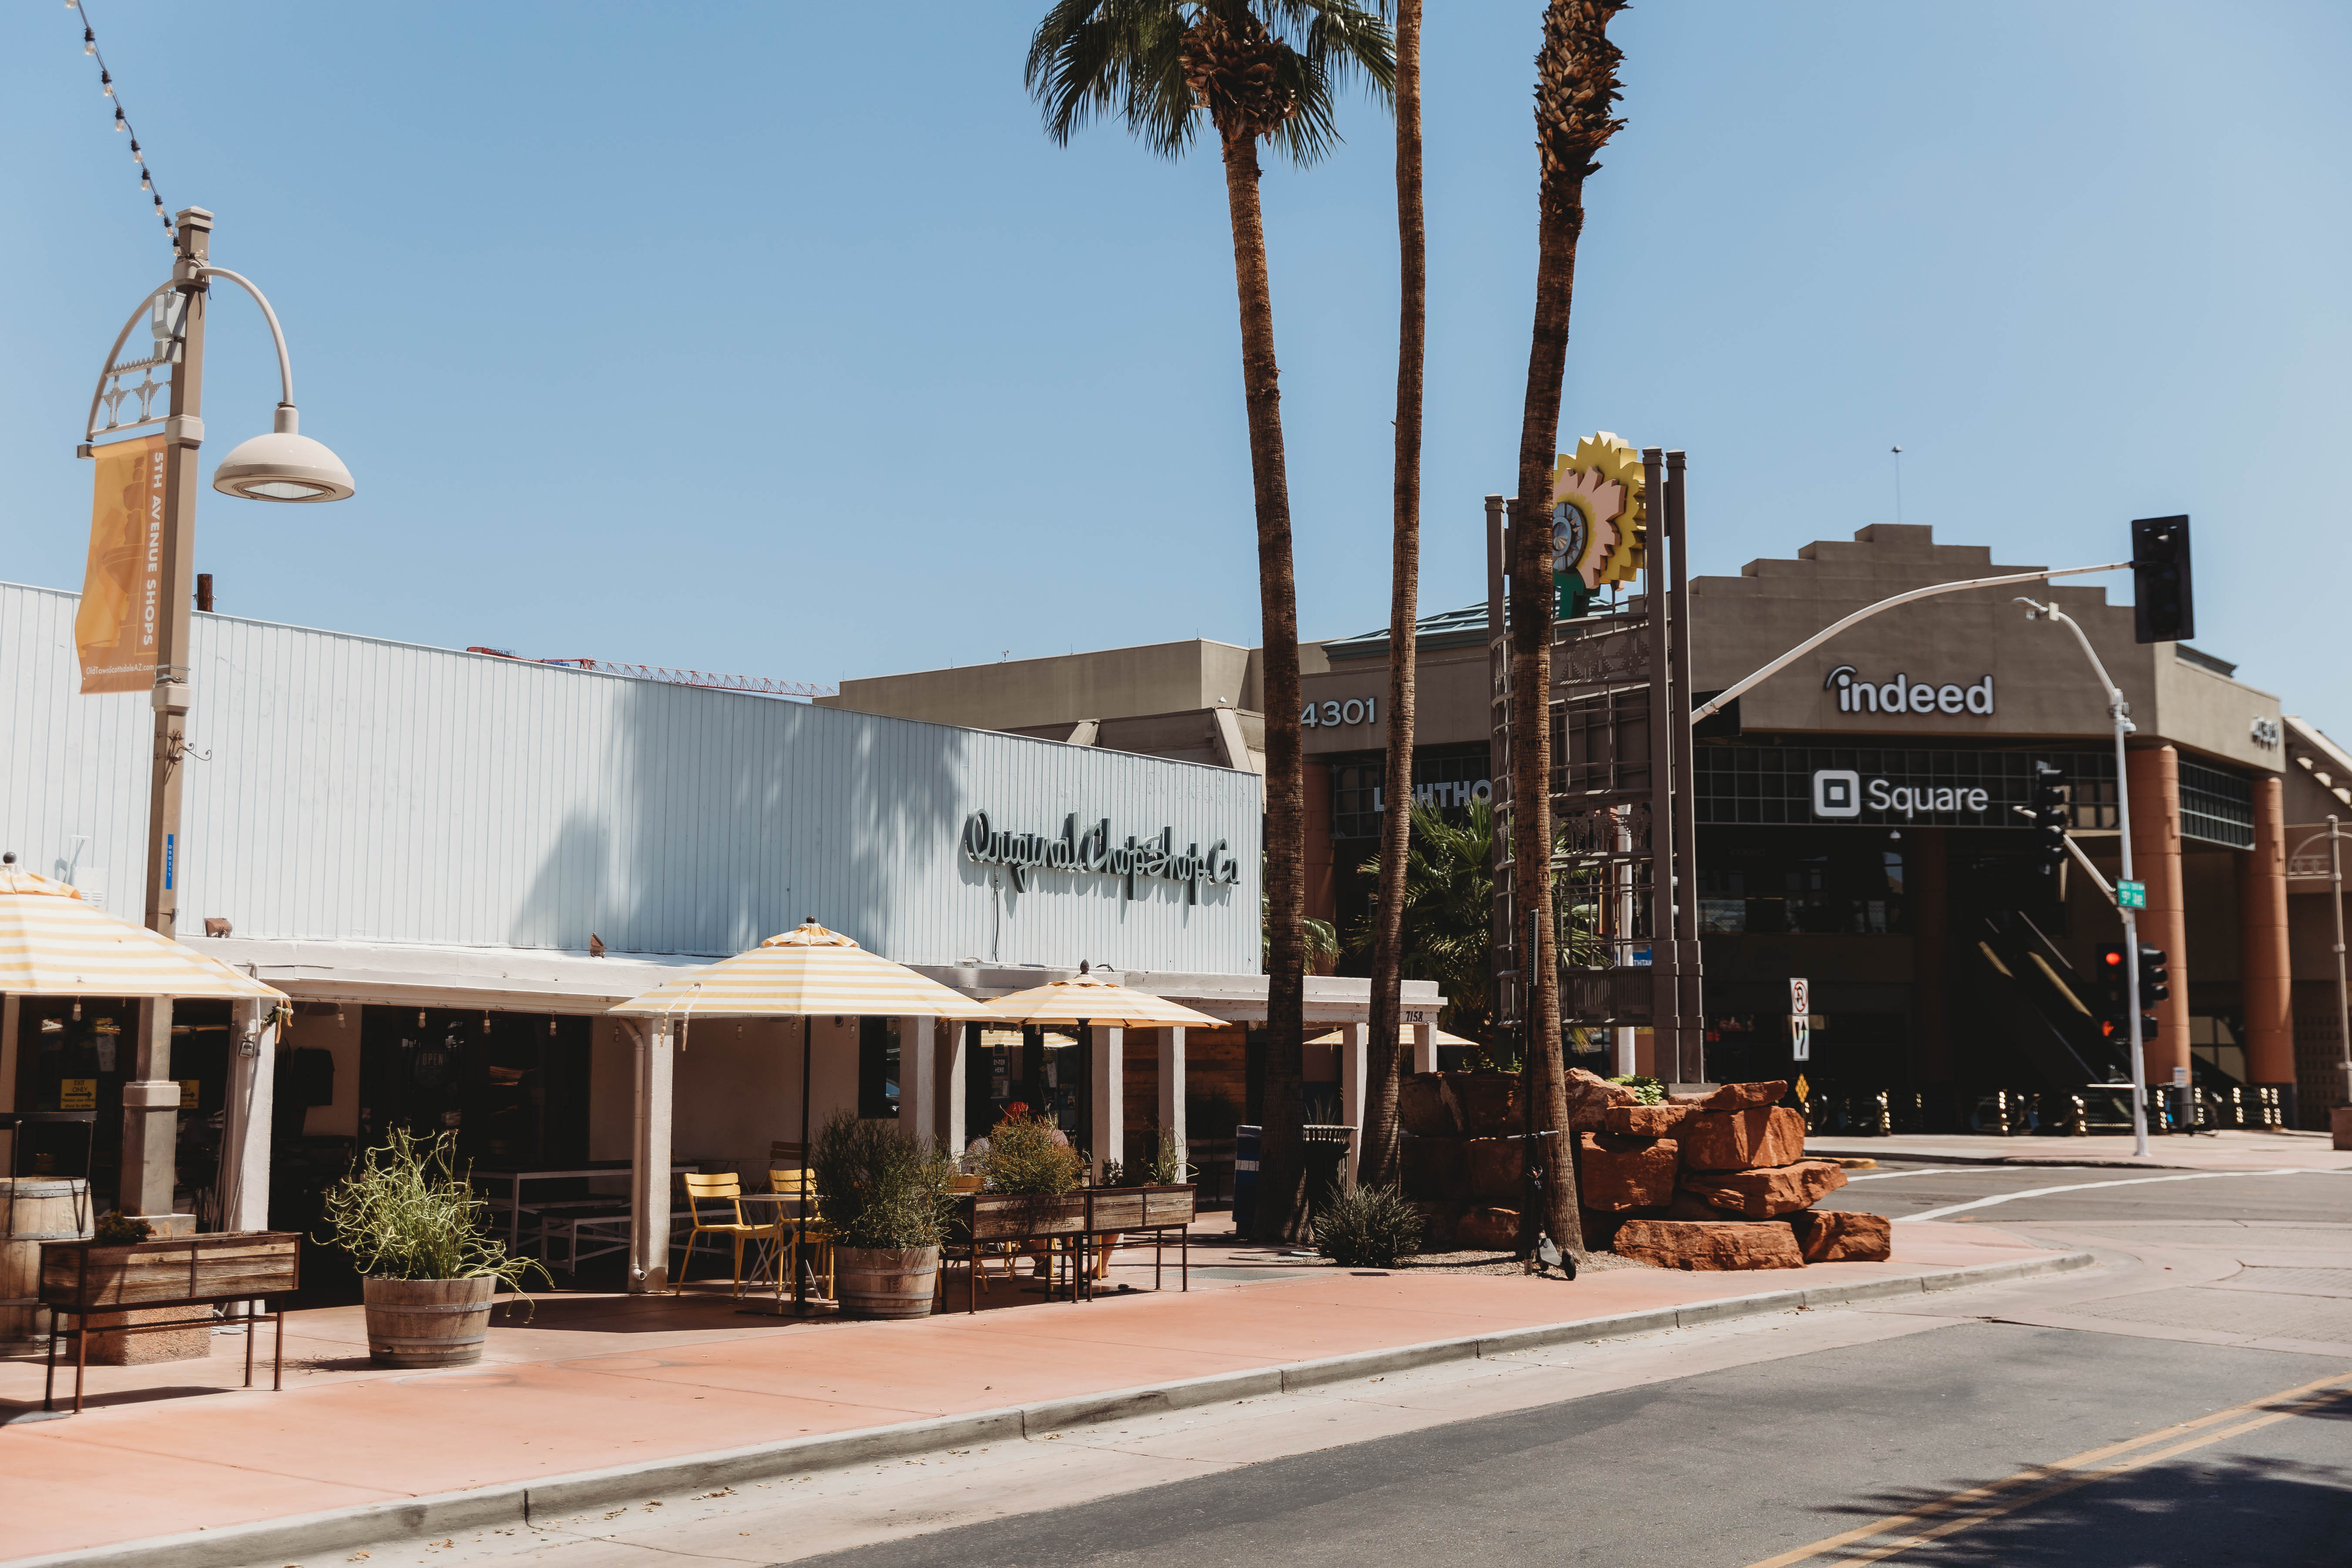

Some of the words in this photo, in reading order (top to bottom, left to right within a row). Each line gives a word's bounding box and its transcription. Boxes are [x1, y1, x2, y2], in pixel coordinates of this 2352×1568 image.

[154, 452, 164, 488] 5TH
[148, 495, 161, 572] AVENUE
[144, 579, 157, 645] SHOPS
[86, 663, 154, 675] OldTownScottsdaleAZ.com
[1826, 665, 1994, 715] indeed
[1301, 697, 1375, 728] 4301
[1869, 779, 1989, 818] Square
[965, 808, 1086, 893] Original
[1406, 1011, 1423, 1022] 7158
[423, 1053, 443, 1065] OPEN
